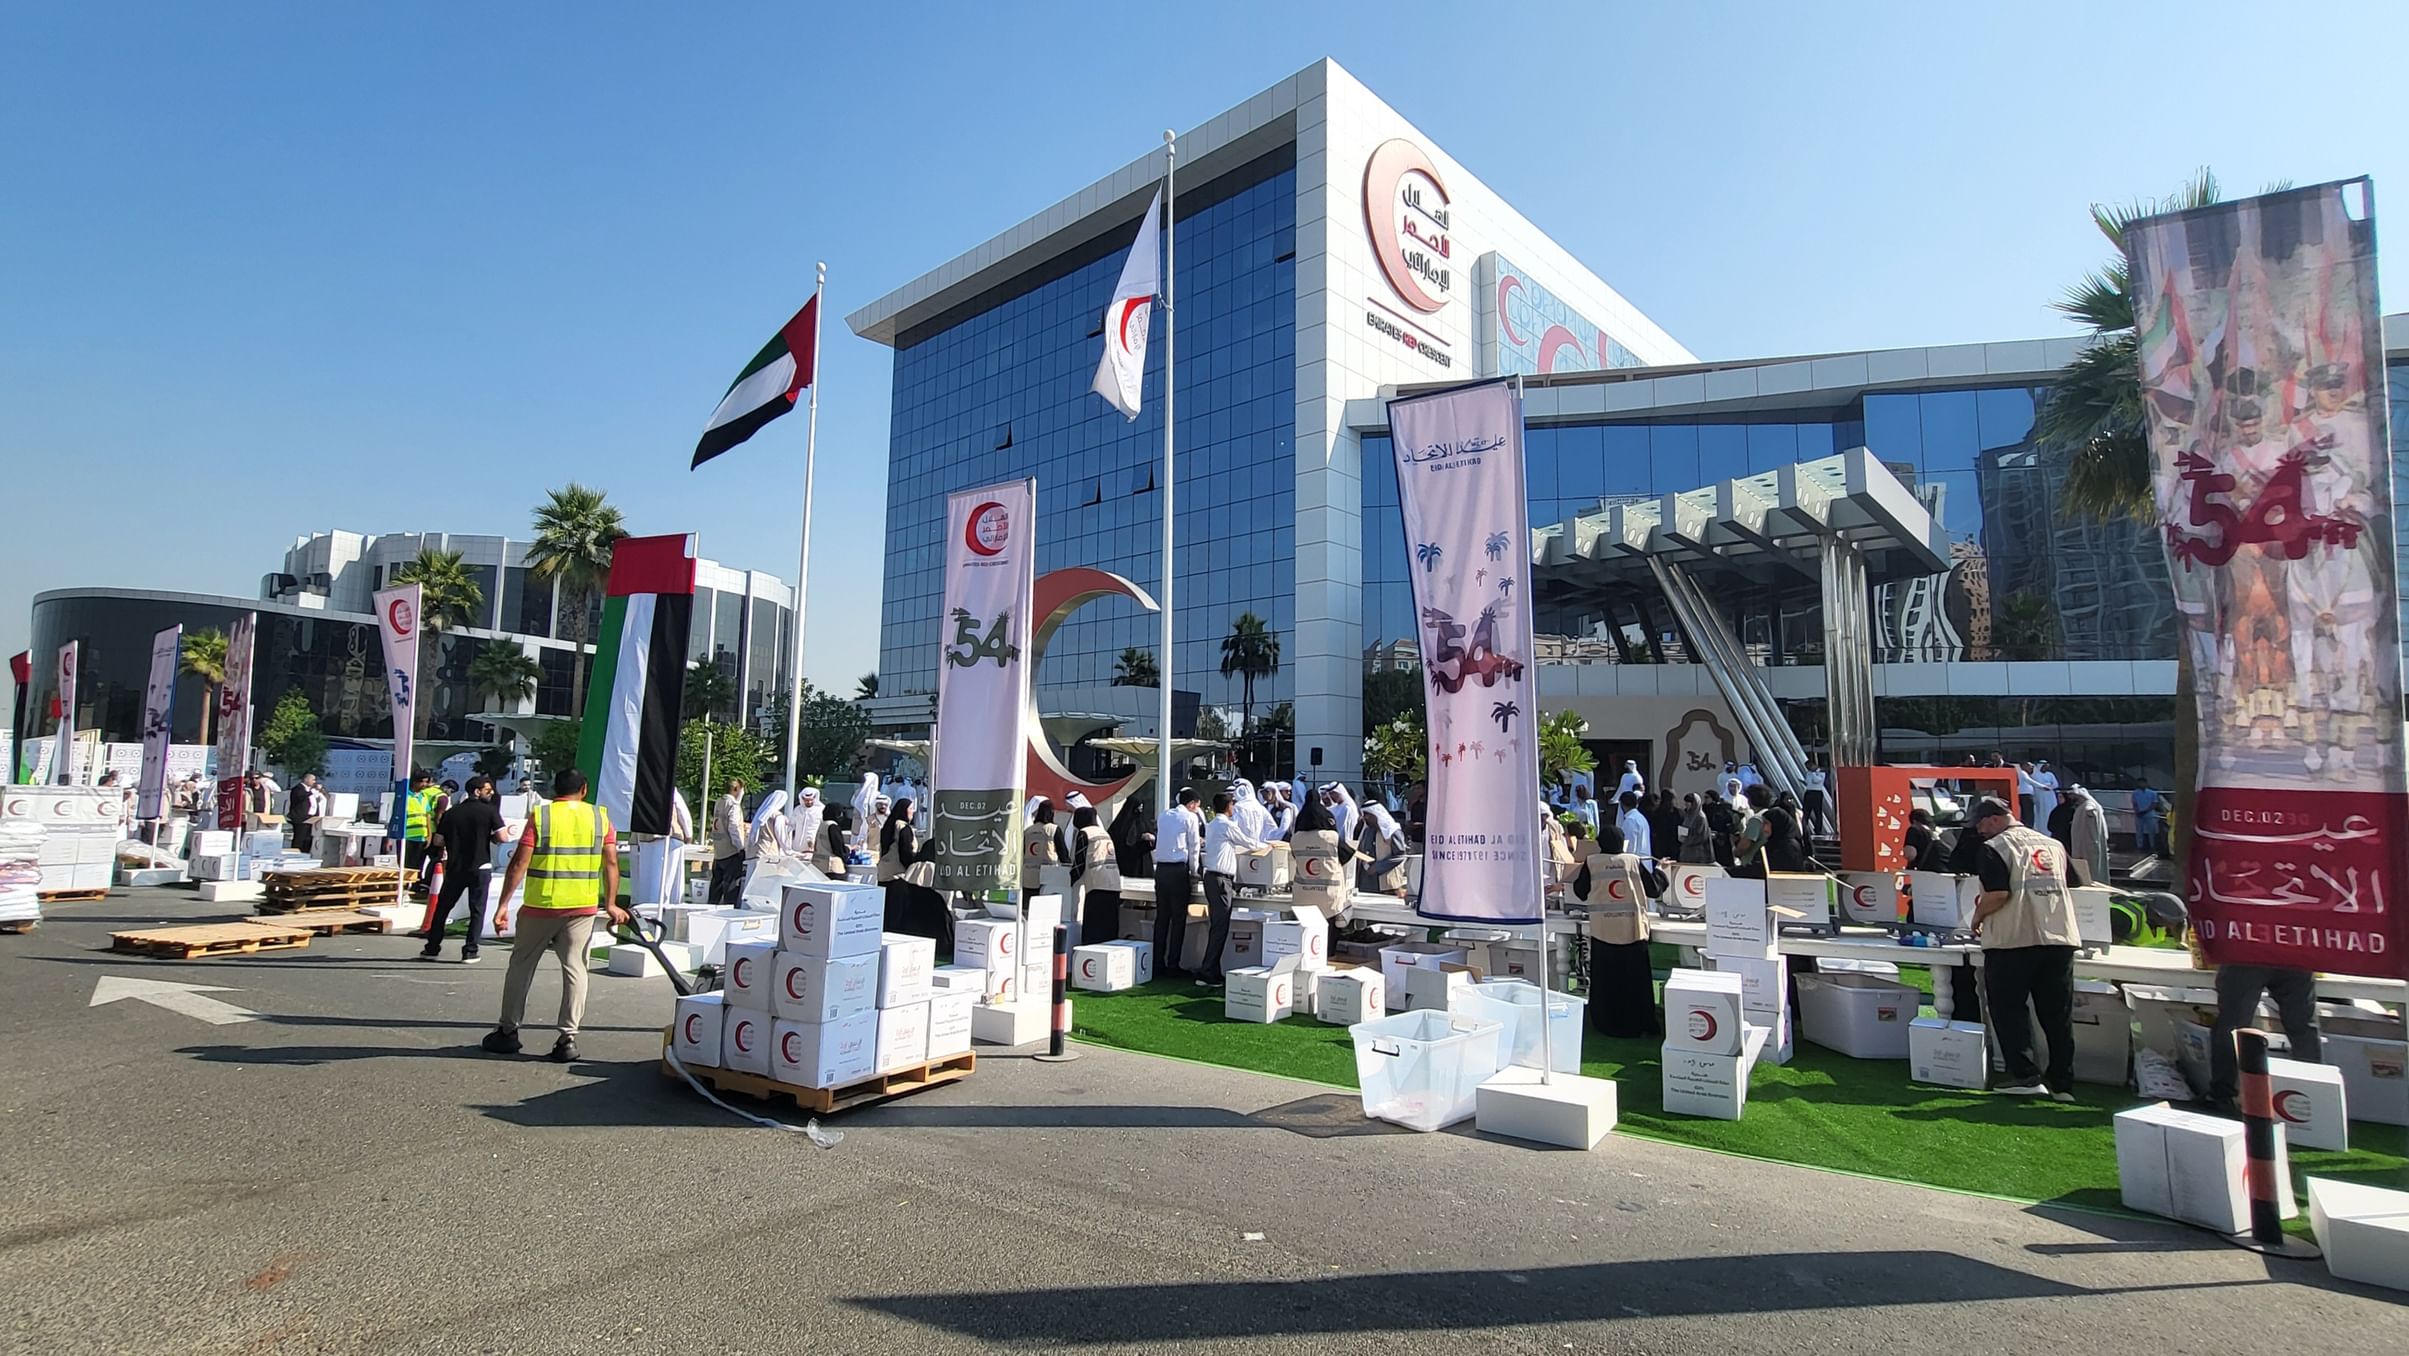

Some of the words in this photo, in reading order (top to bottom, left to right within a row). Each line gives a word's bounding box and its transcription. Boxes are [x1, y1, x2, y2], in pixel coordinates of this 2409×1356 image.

[1402, 183, 1449, 231] الهلال
[1402, 214, 1449, 259] الأحمر
[1402, 248, 1449, 292] الإماراتي
[1367, 311, 1402, 344] EMIRATES
[1402, 331, 1417, 350] RED
[1418, 341, 1451, 368] CRESCENT
[1430, 463, 1442, 472] EID
[1456, 457, 1482, 468] ETIHAD
[982, 513, 1009, 523] الهلال
[2180, 452, 2338, 567] 54
[949, 610, 1012, 668] 54
[1427, 607, 1508, 694] 54
[1687, 751, 1715, 771] 54
[936, 801, 1018, 822] عيد
[960, 802, 986, 810] DEC.02
[2221, 809, 2284, 825] DEC.02
[1431, 834, 1444, 845] EID
[1449, 835, 1456, 845] AL
[1457, 834, 1486, 845] ETIHAD
[940, 865, 951, 876] ID
[957, 864, 970, 877] AL
[976, 864, 1016, 877] ETIHAD
[2228, 920, 2260, 942] AL
[2275, 924, 2386, 953] ETIHAD
